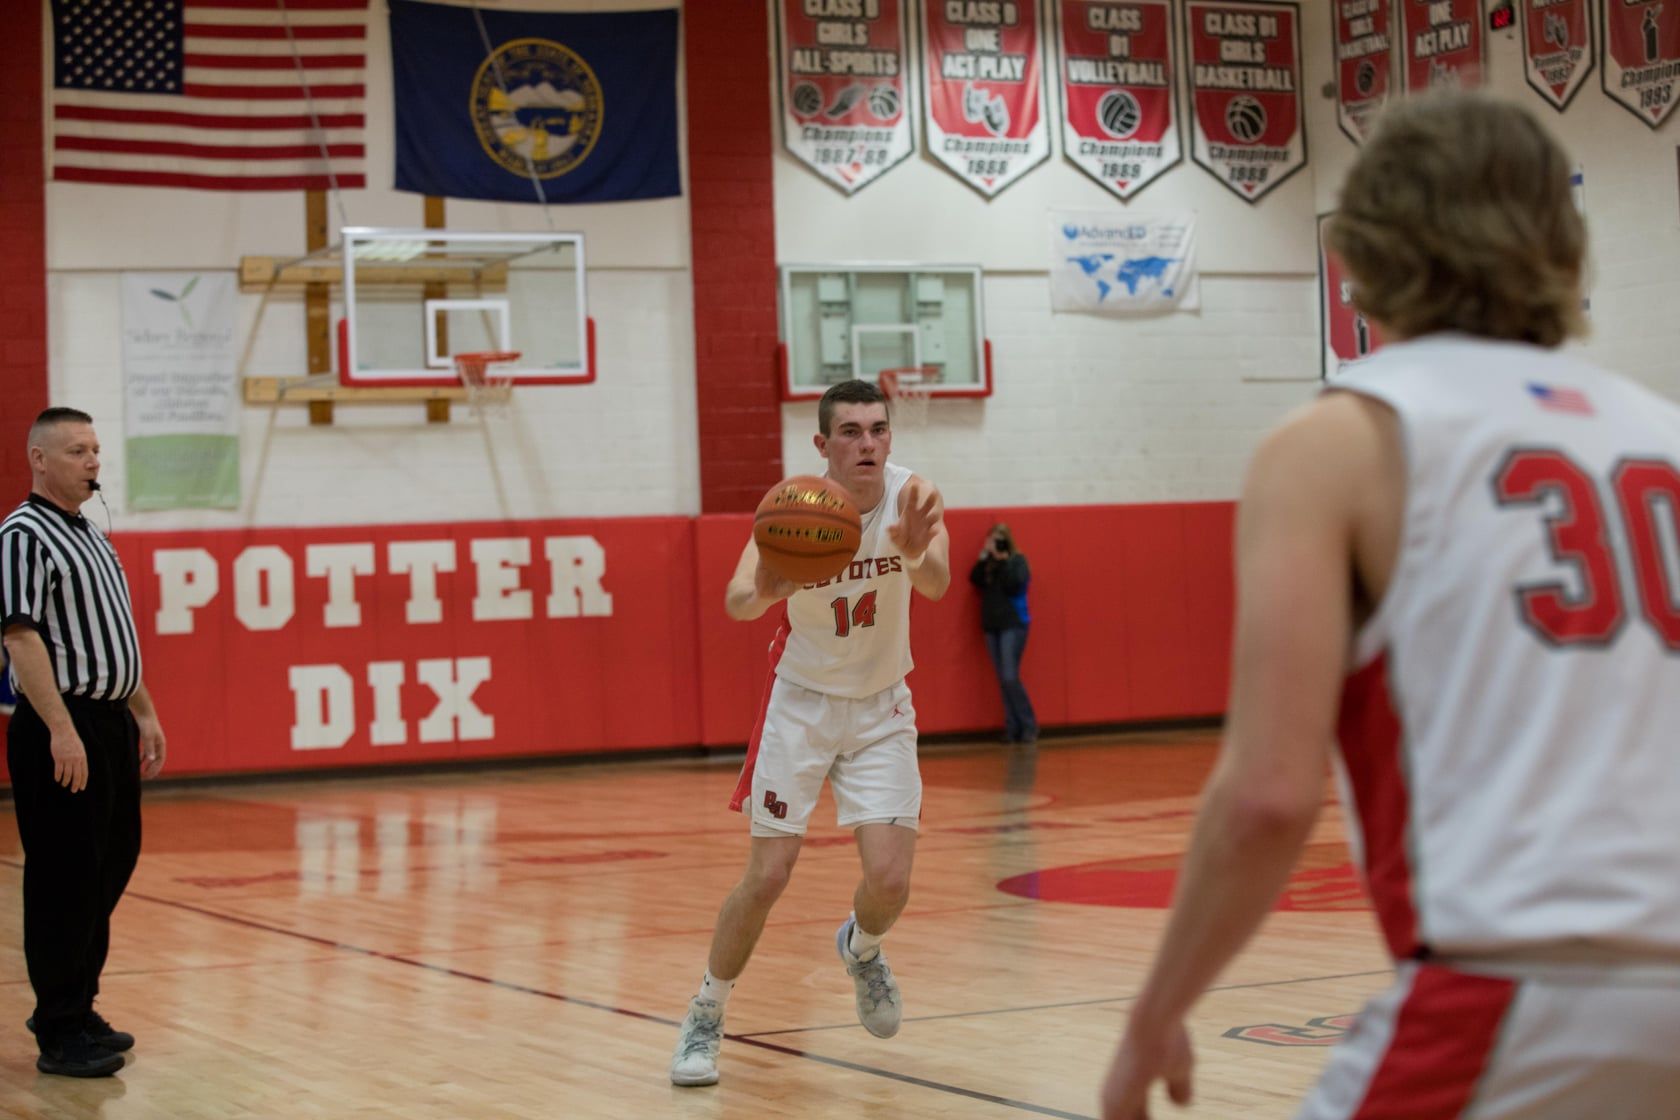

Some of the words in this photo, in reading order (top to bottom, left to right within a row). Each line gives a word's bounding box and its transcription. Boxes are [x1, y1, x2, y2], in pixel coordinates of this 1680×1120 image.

[945, 1, 999, 23] CLASS
[1087, 7, 1141, 31] CLASS
[1204, 12, 1257, 36] CLASS
[817, 21, 868, 45] GIRLS
[965, 28, 999, 52] ONE
[1439, 22, 1471, 53] PLAY
[1221, 40, 1265, 64] GIRLS
[942, 54, 976, 78] ACT
[979, 55, 1026, 81] PLAY
[1068, 59, 1168, 85] VOLLEYBALL
[1195, 65, 1295, 90] BASKETBALL
[803, 126, 895, 143] Champions
[943, 138, 1031, 155] Champions
[1079, 141, 1163, 159] Champions
[1208, 144, 1290, 162] Champions
[1488, 445, 1680, 656] 30
[153, 534, 613, 636] POTTER
[830, 589, 878, 638] 14
[289, 656, 495, 751] DIX
